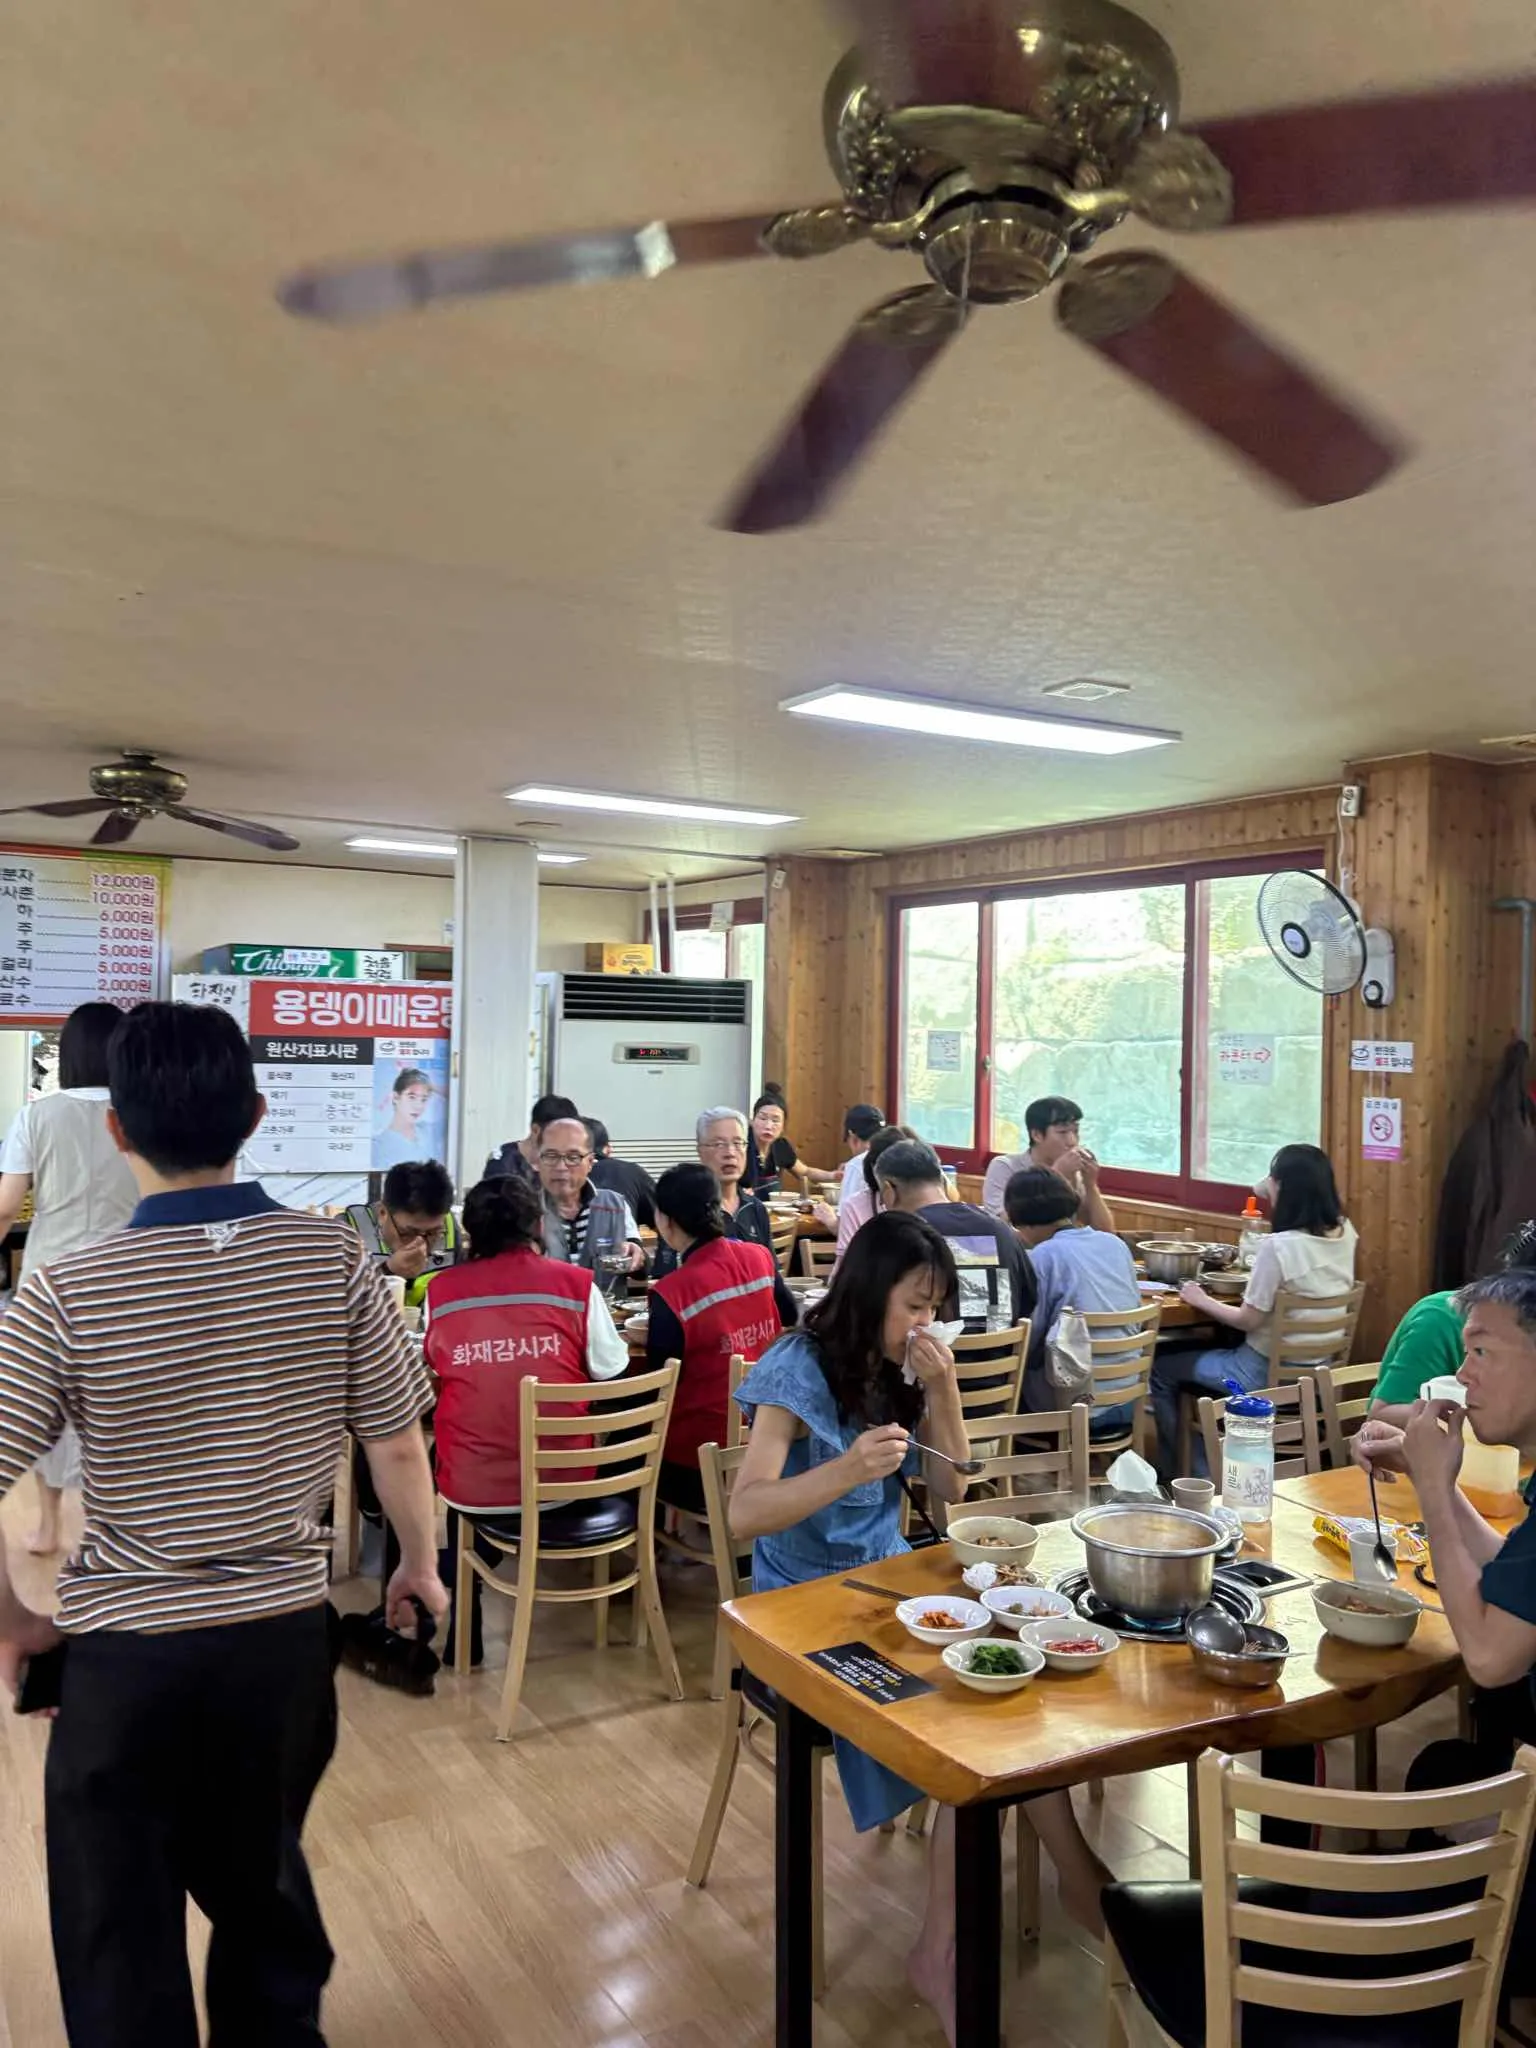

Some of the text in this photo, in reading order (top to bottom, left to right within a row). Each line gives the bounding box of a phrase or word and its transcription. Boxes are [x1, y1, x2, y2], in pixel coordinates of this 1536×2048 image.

[0, 886, 34, 900] 사춘
[265, 1042, 359, 1059] 원산지표시판
[451, 1332, 561, 1367] 화재감시자
